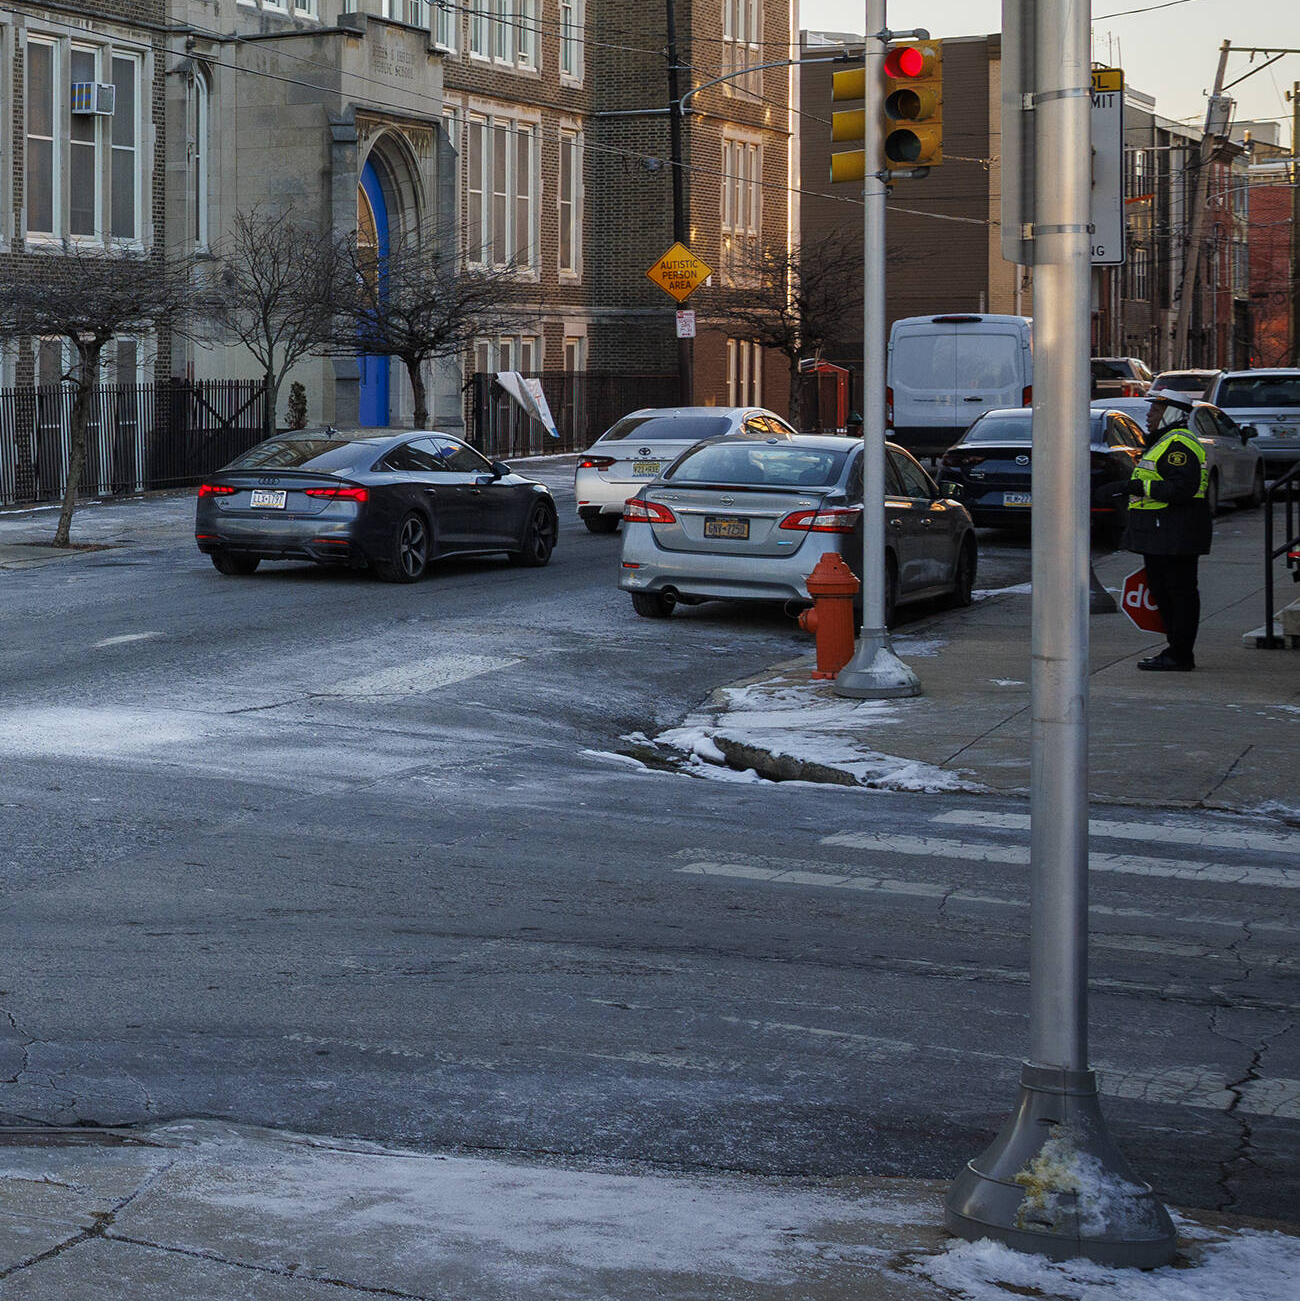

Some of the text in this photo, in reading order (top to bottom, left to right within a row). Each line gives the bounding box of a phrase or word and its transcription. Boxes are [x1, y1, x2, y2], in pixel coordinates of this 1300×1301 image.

[1091, 93, 1115, 109] MIT
[660, 259, 698, 270] AUTISTIC
[662, 270, 697, 280] PERSON
[669, 280, 692, 290] AREA
